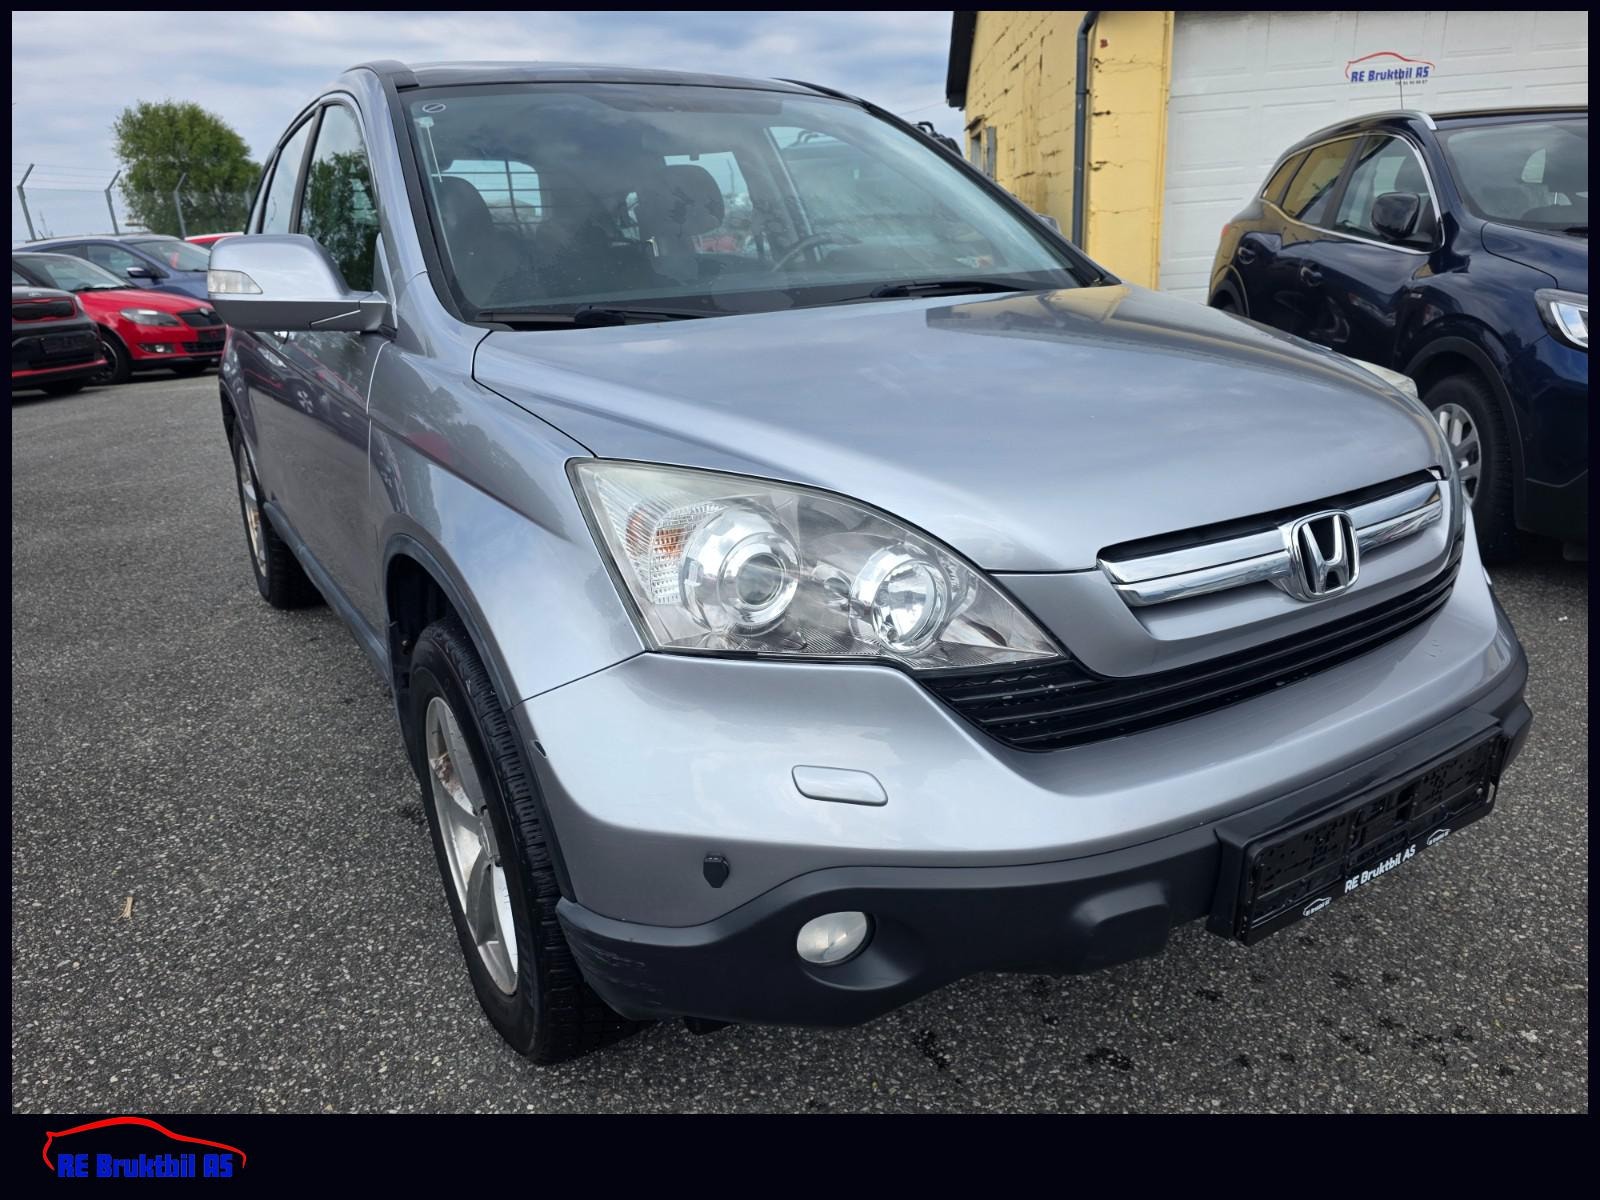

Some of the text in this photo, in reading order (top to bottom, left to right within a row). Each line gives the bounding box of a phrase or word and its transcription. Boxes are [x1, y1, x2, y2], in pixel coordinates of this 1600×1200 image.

[1351, 66, 1430, 82] RE Bruktbil AS
[1344, 844, 1417, 894] RE Bruktbil AS
